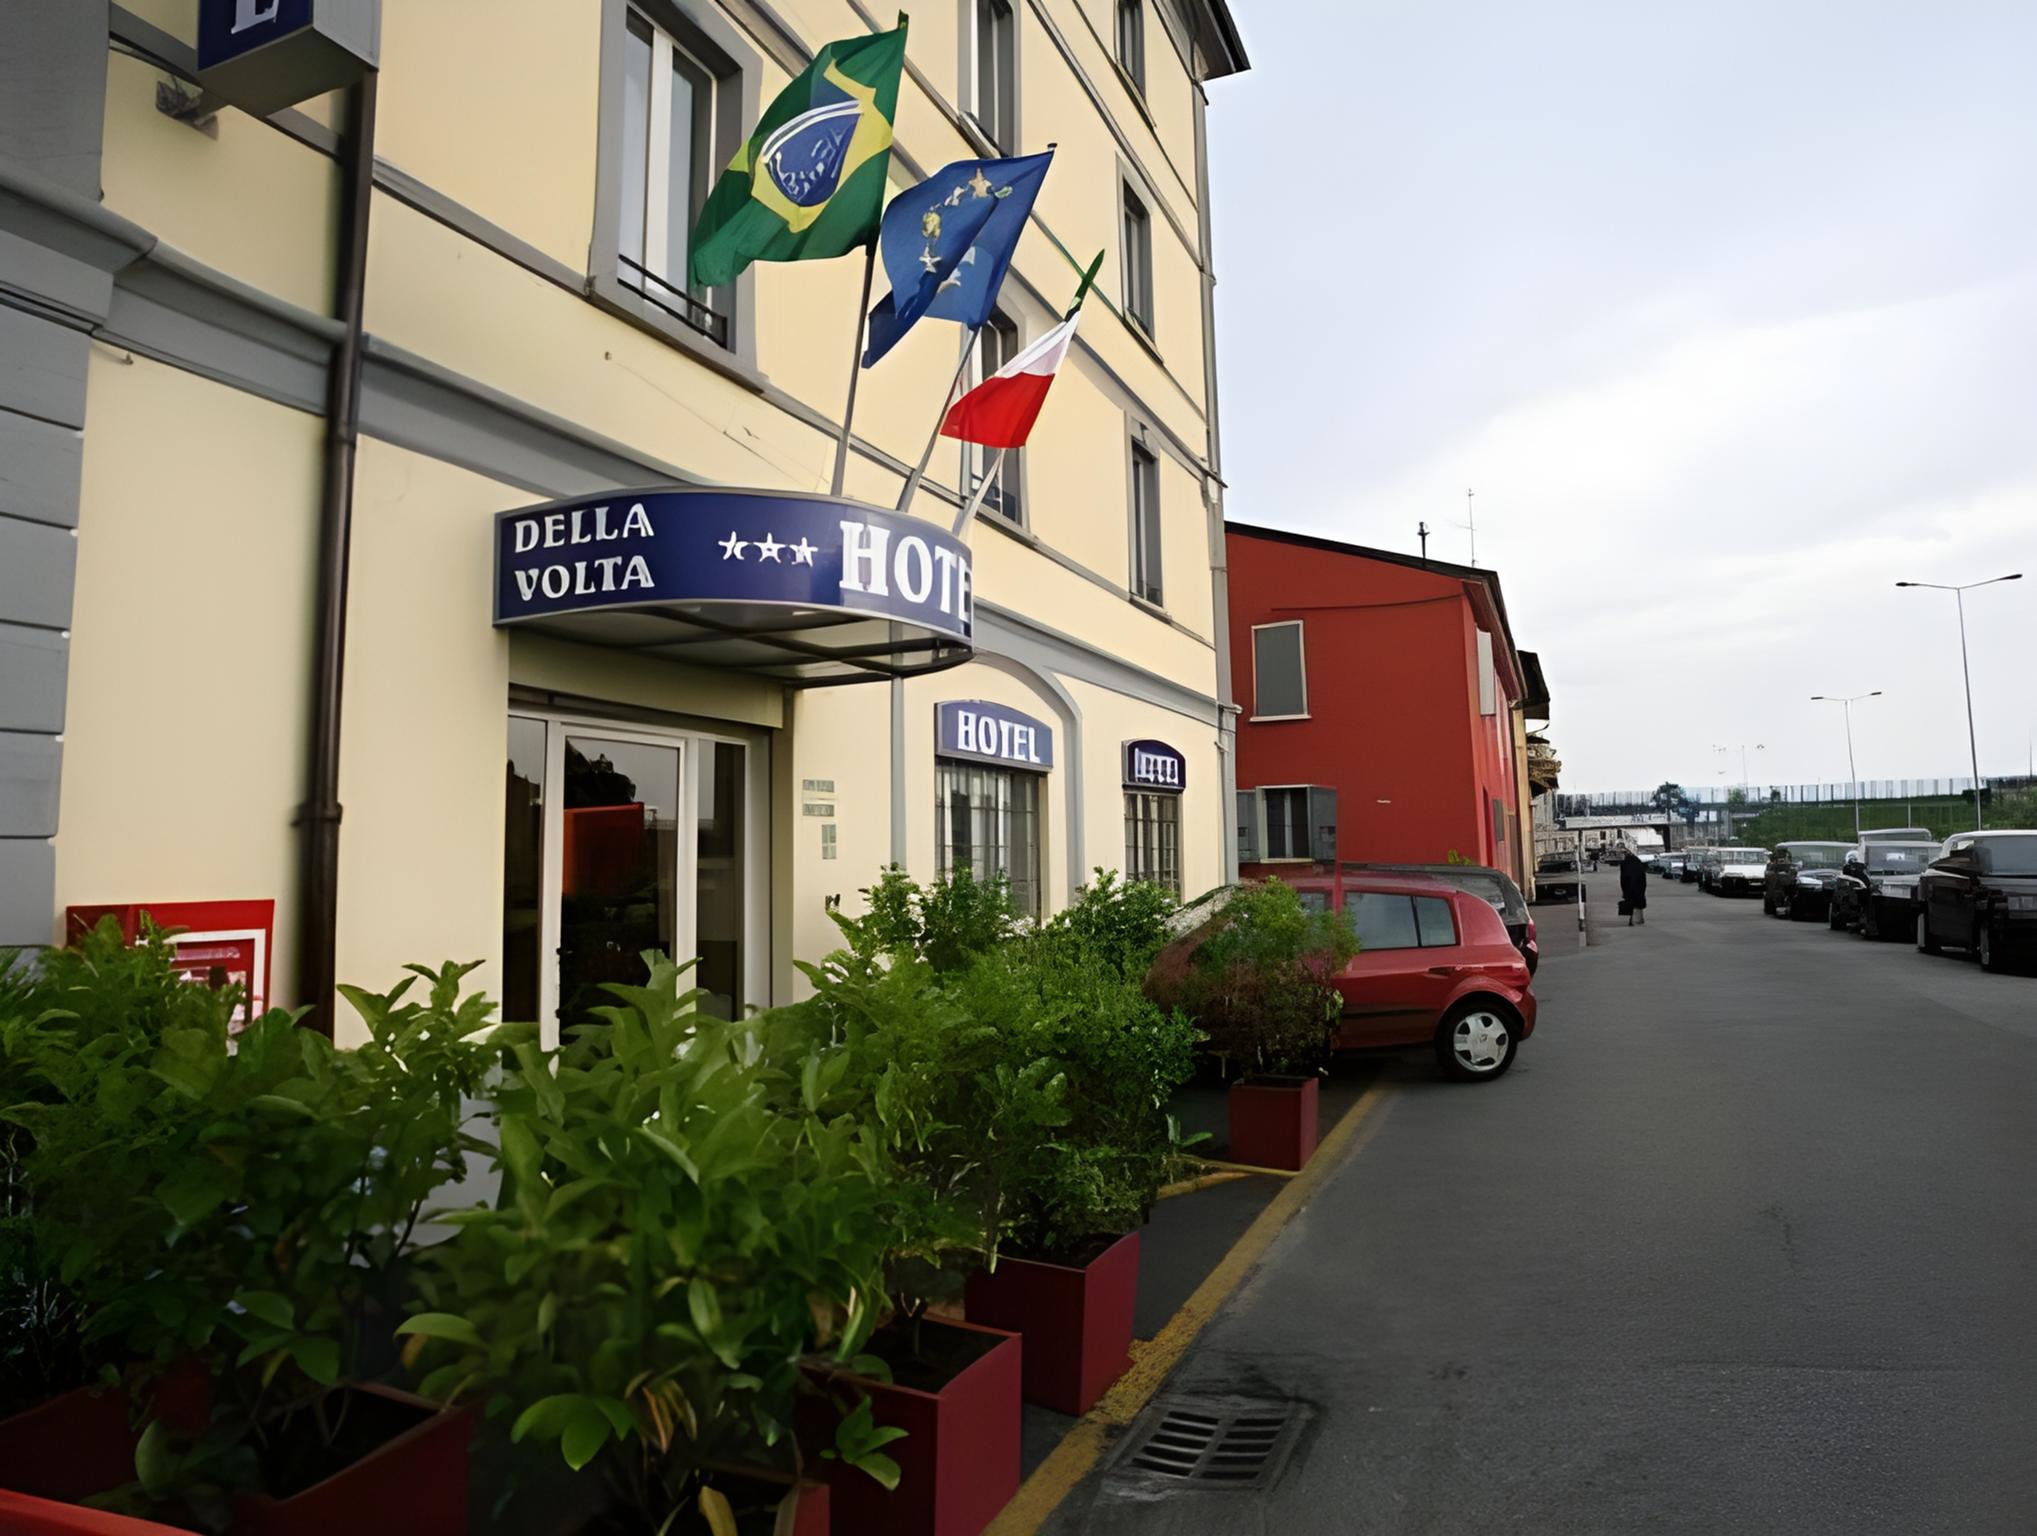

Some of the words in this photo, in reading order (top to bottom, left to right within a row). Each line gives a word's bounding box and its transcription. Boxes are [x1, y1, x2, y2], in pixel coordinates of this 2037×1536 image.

[514, 502, 655, 553] DELLA
[514, 555, 656, 602] VOLTA
[957, 710, 1041, 764] HOTEL
